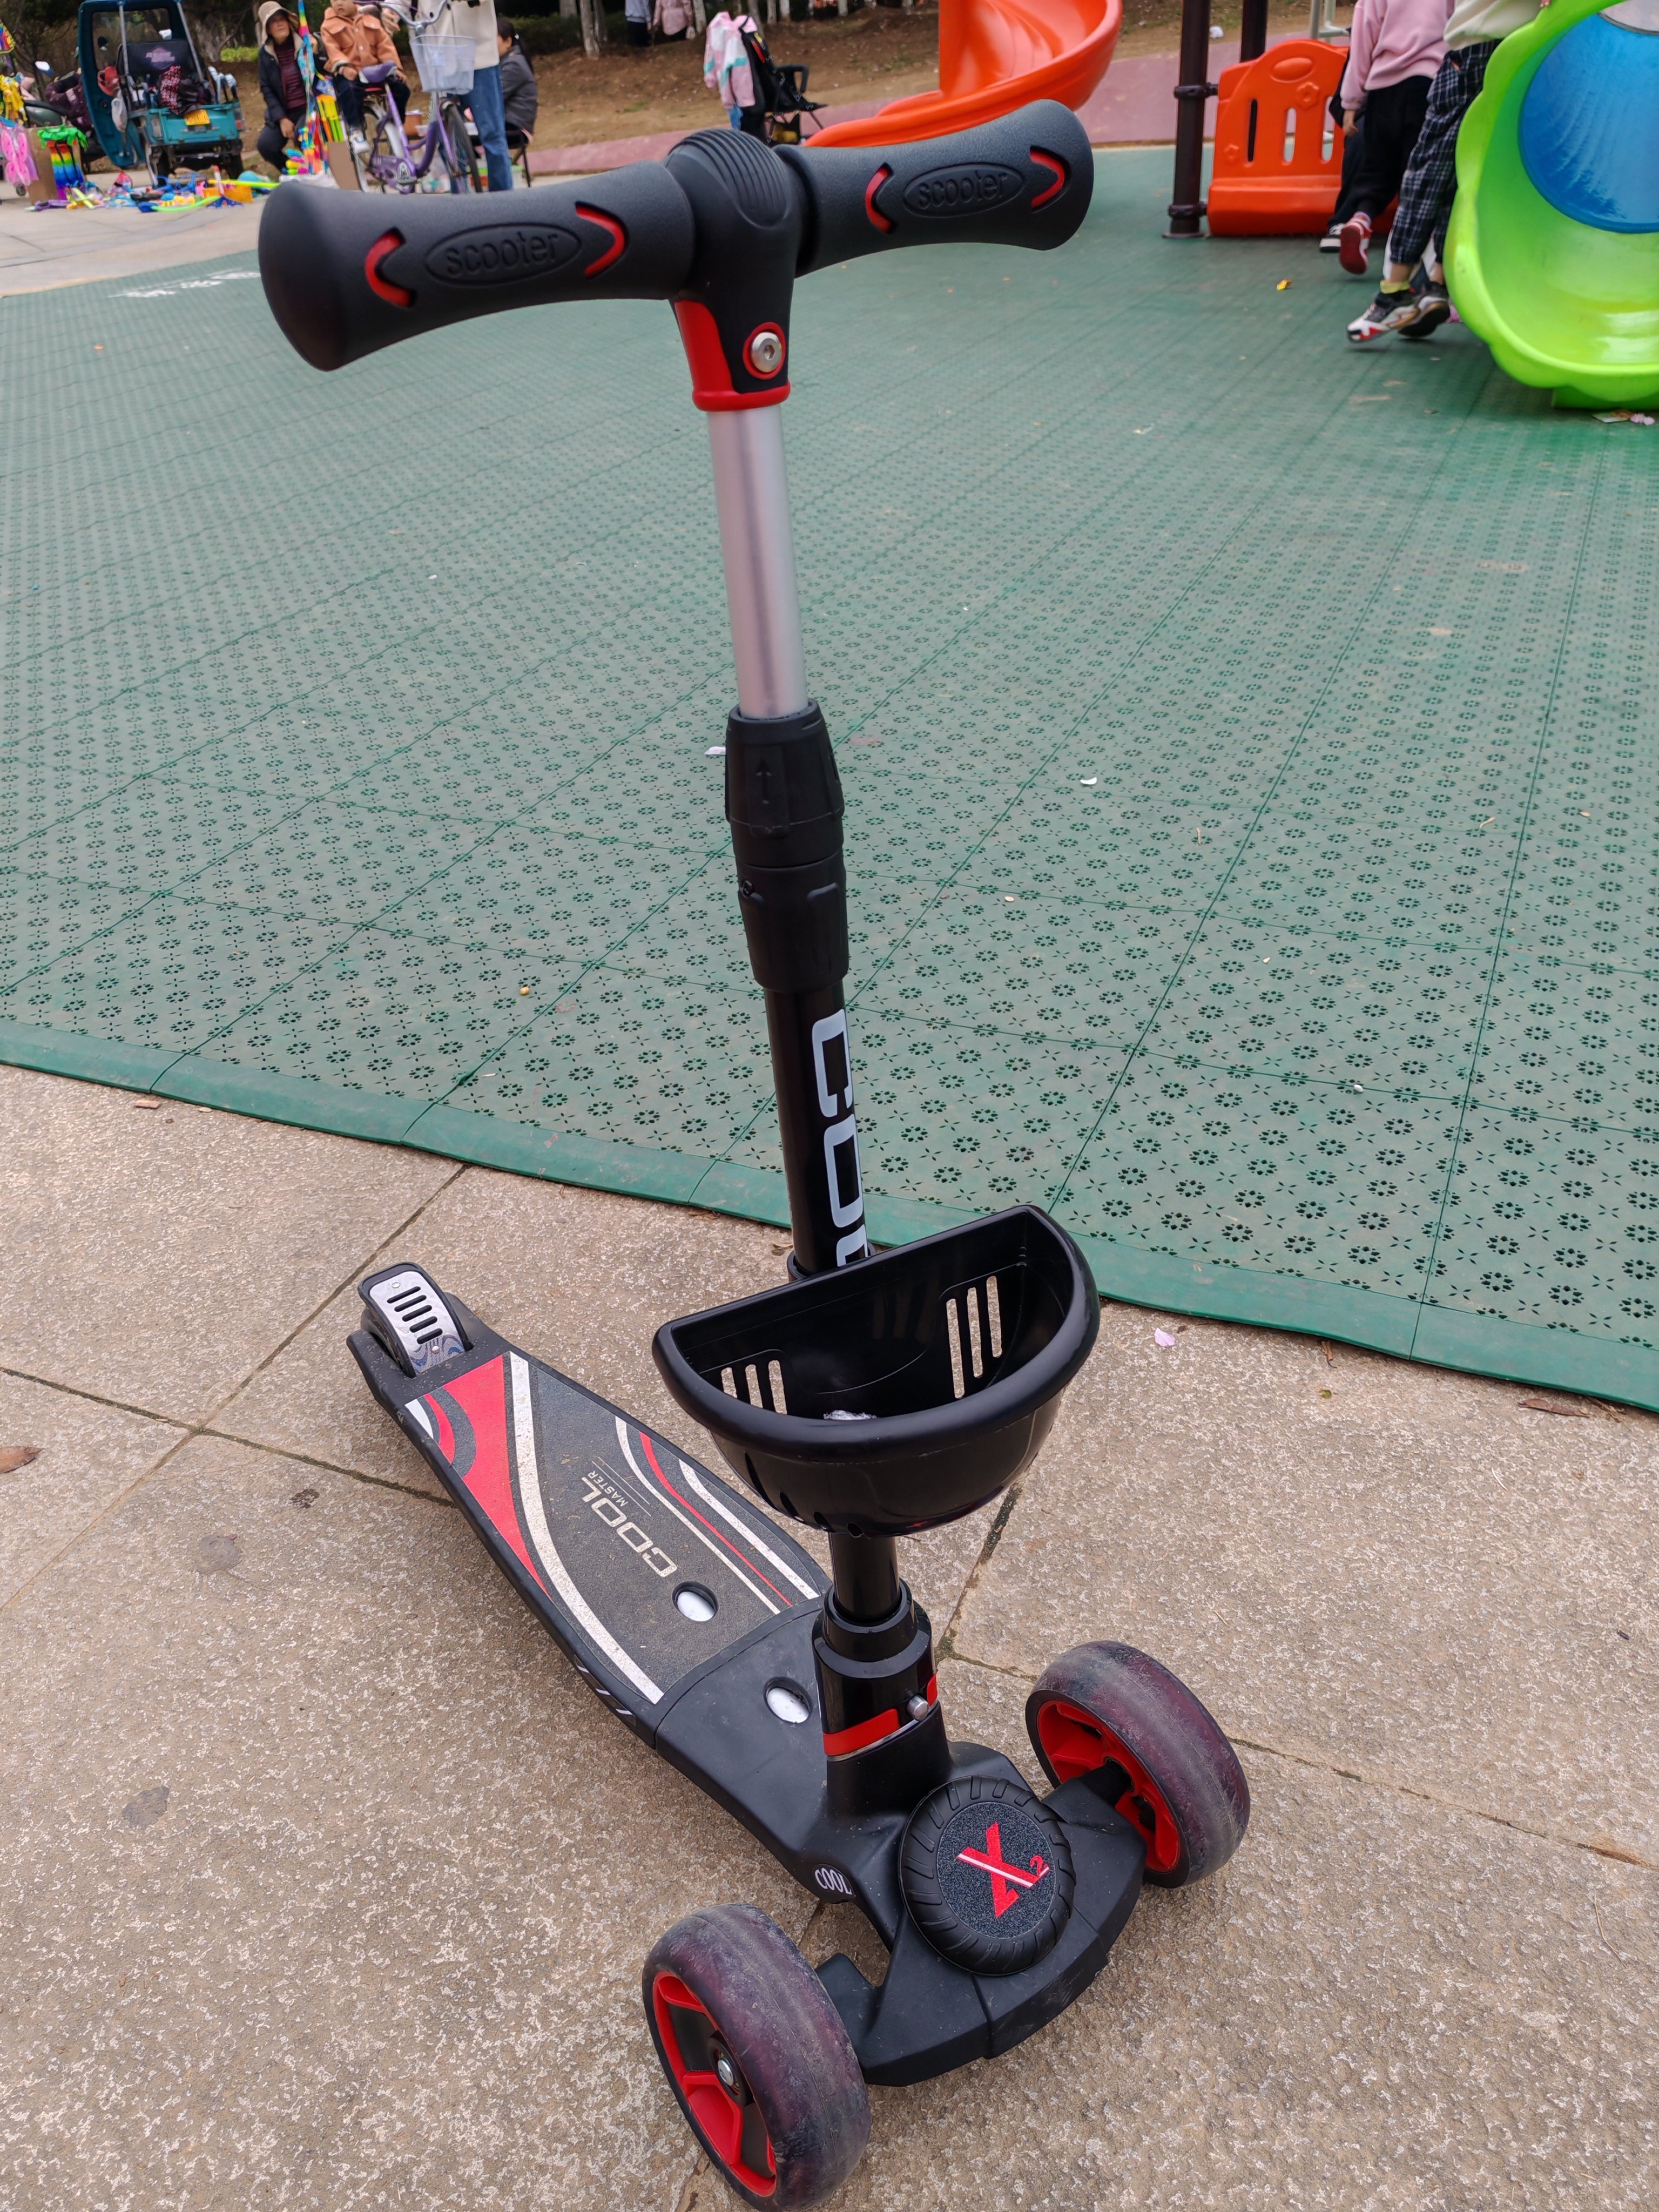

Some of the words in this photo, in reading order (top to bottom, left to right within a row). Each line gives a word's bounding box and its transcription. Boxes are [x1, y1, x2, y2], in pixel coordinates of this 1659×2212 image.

[918, 170, 1008, 210] scooter
[446, 231, 559, 274] scooter
[588, 1470, 628, 1507] MASTER
[582, 1476, 677, 1577] COOL
[814, 1867, 852, 1895] COOL
